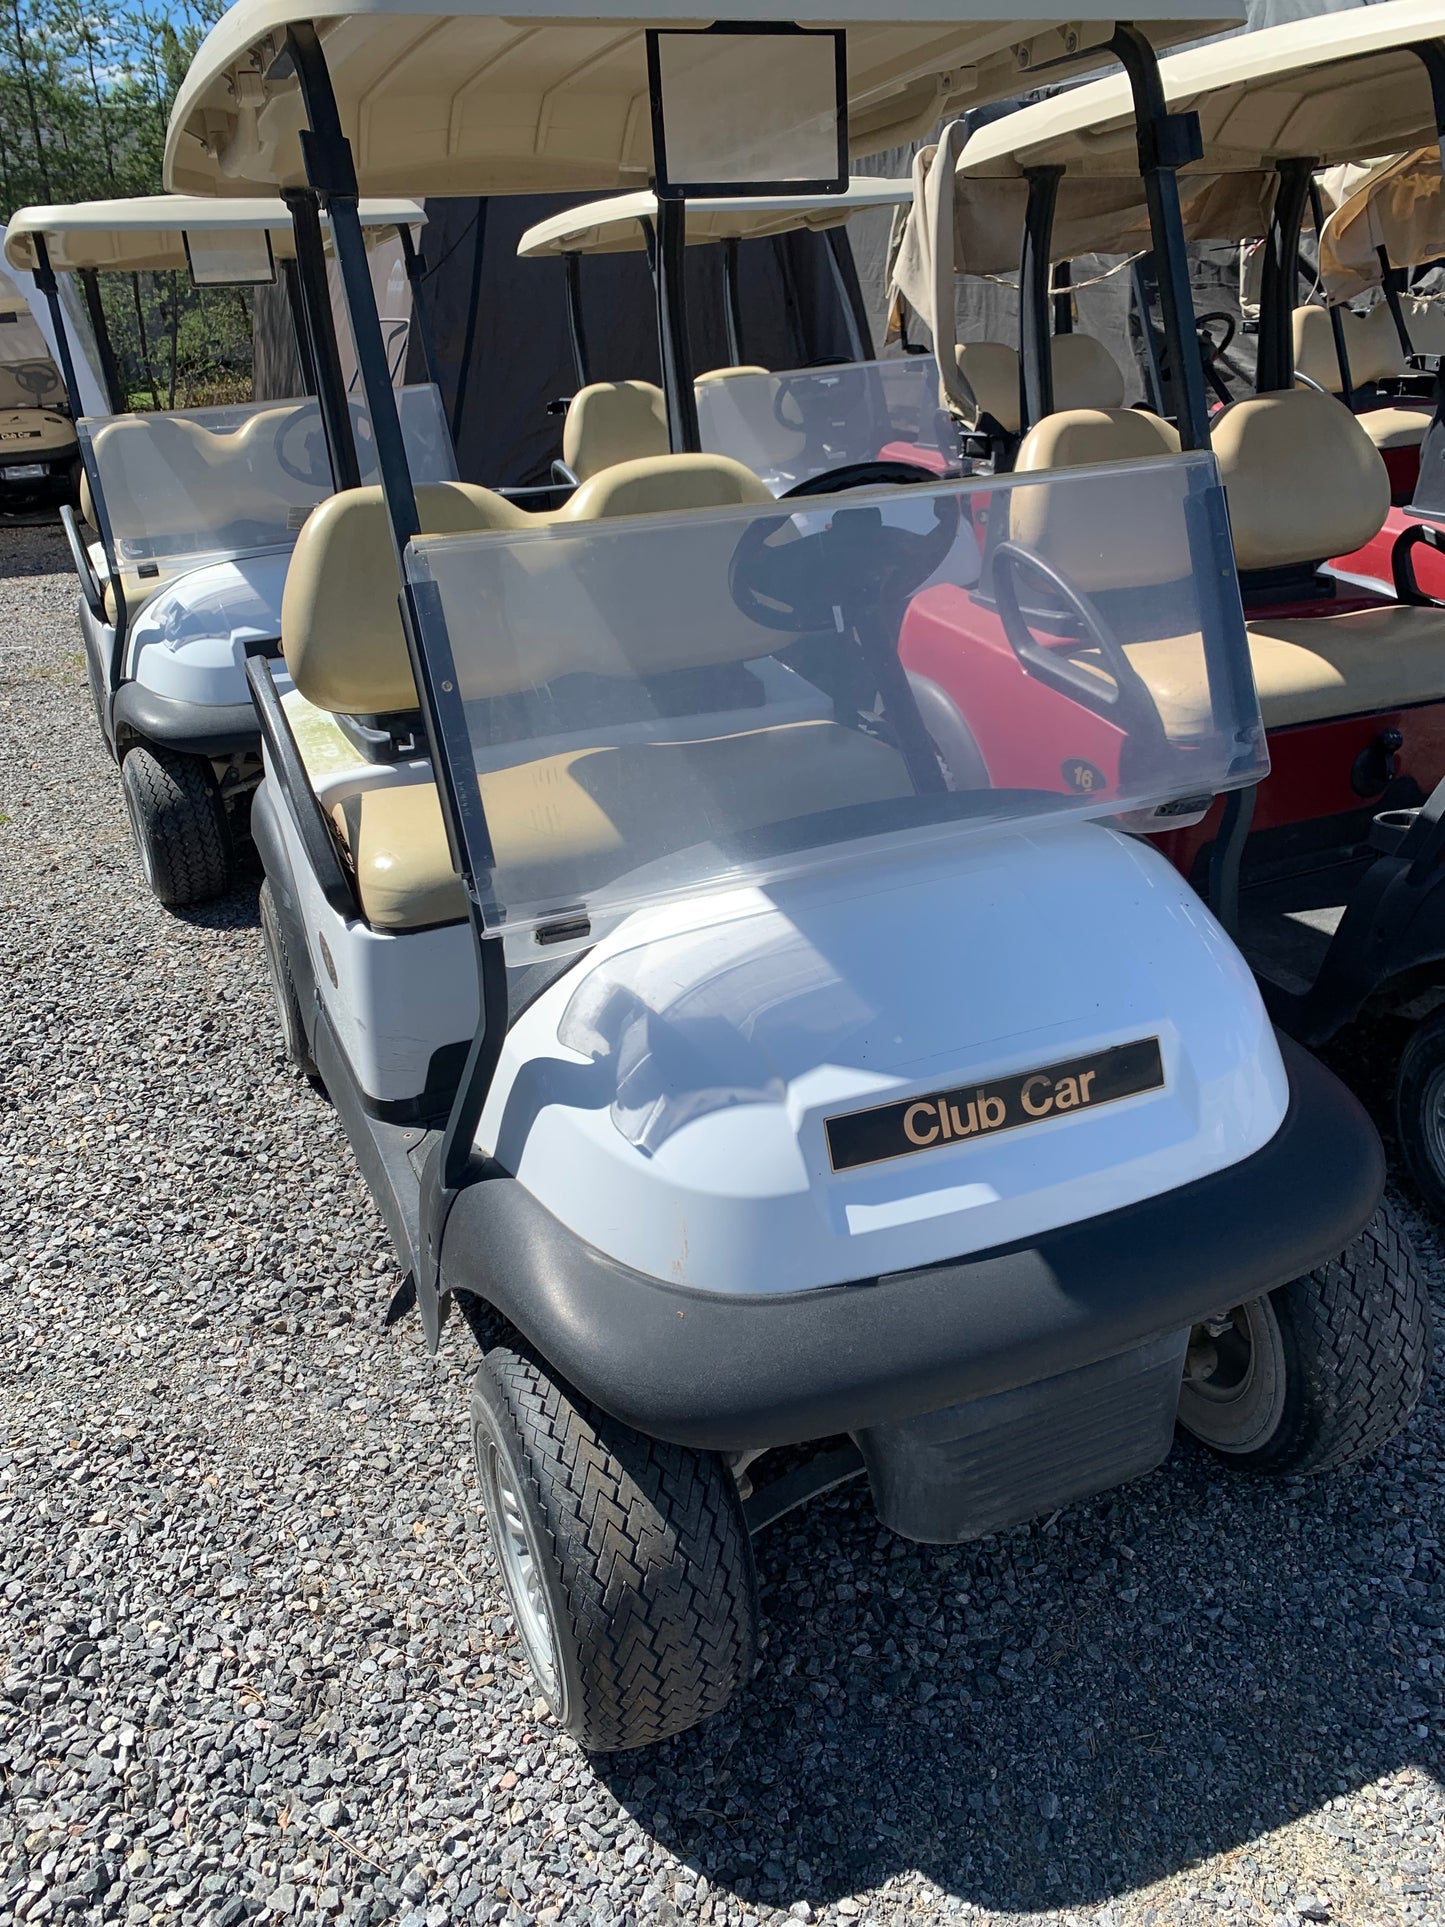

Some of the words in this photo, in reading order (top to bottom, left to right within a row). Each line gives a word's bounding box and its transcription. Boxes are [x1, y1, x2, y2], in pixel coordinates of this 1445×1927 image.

[1074, 766, 1093, 788] 16
[903, 1089, 1006, 1145] Club
[1020, 1070, 1096, 1117] Car
